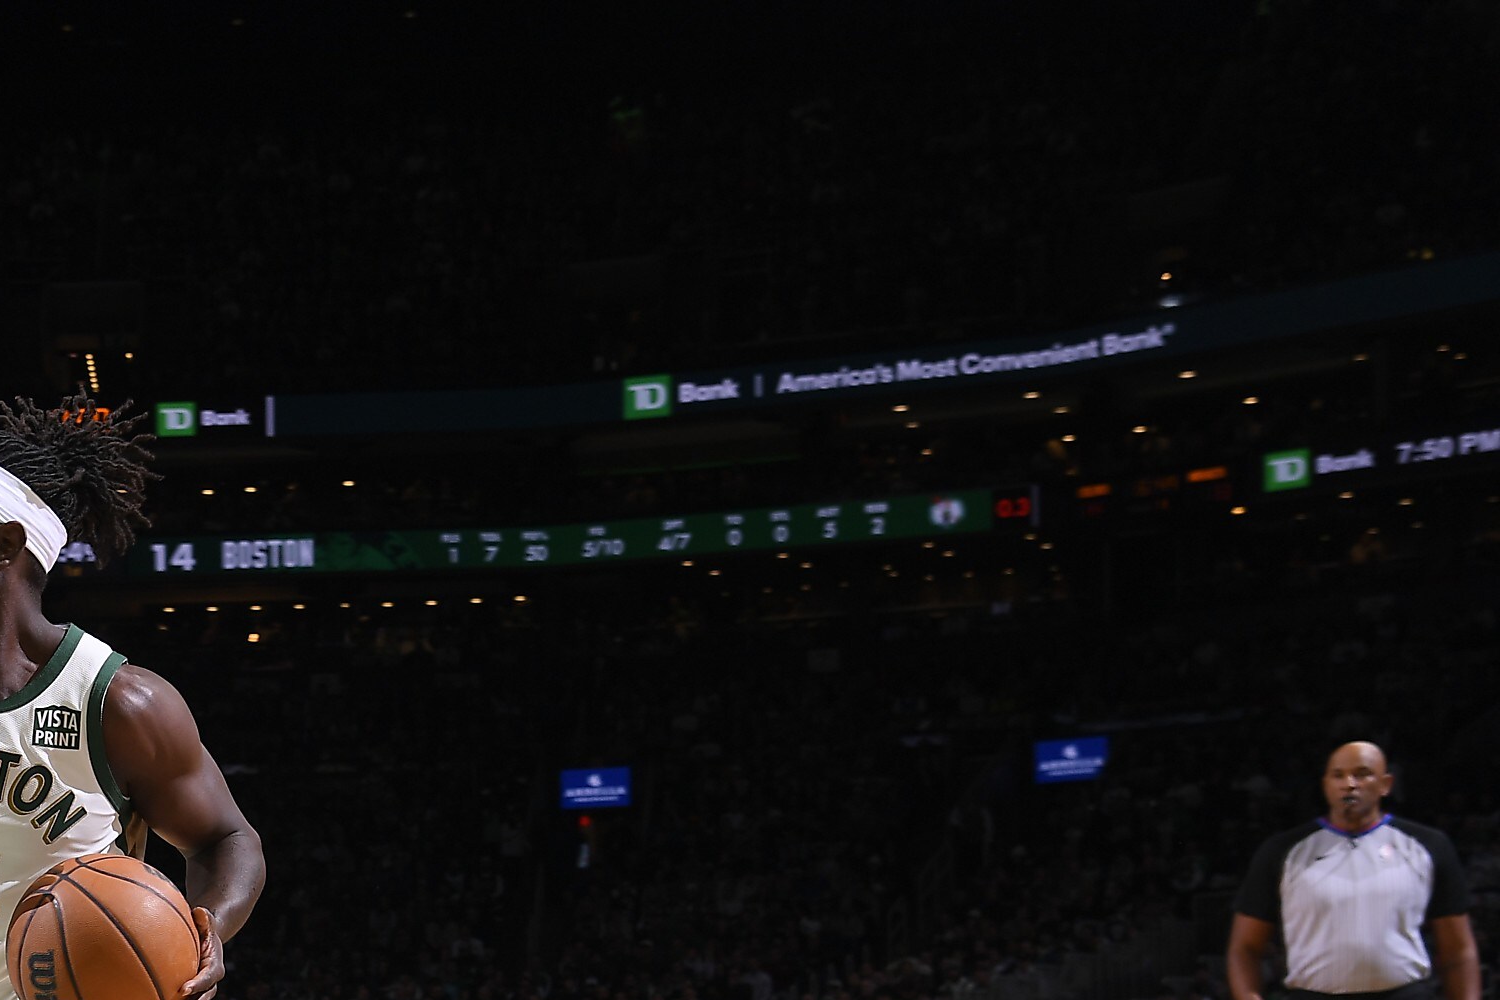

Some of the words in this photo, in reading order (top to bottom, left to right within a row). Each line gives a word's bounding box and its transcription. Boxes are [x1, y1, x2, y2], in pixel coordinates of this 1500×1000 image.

[151, 543, 195, 571] 14
[221, 539, 315, 570] BOSTON
[36, 708, 79, 731] VISTA
[33, 729, 79, 748] PRINT
